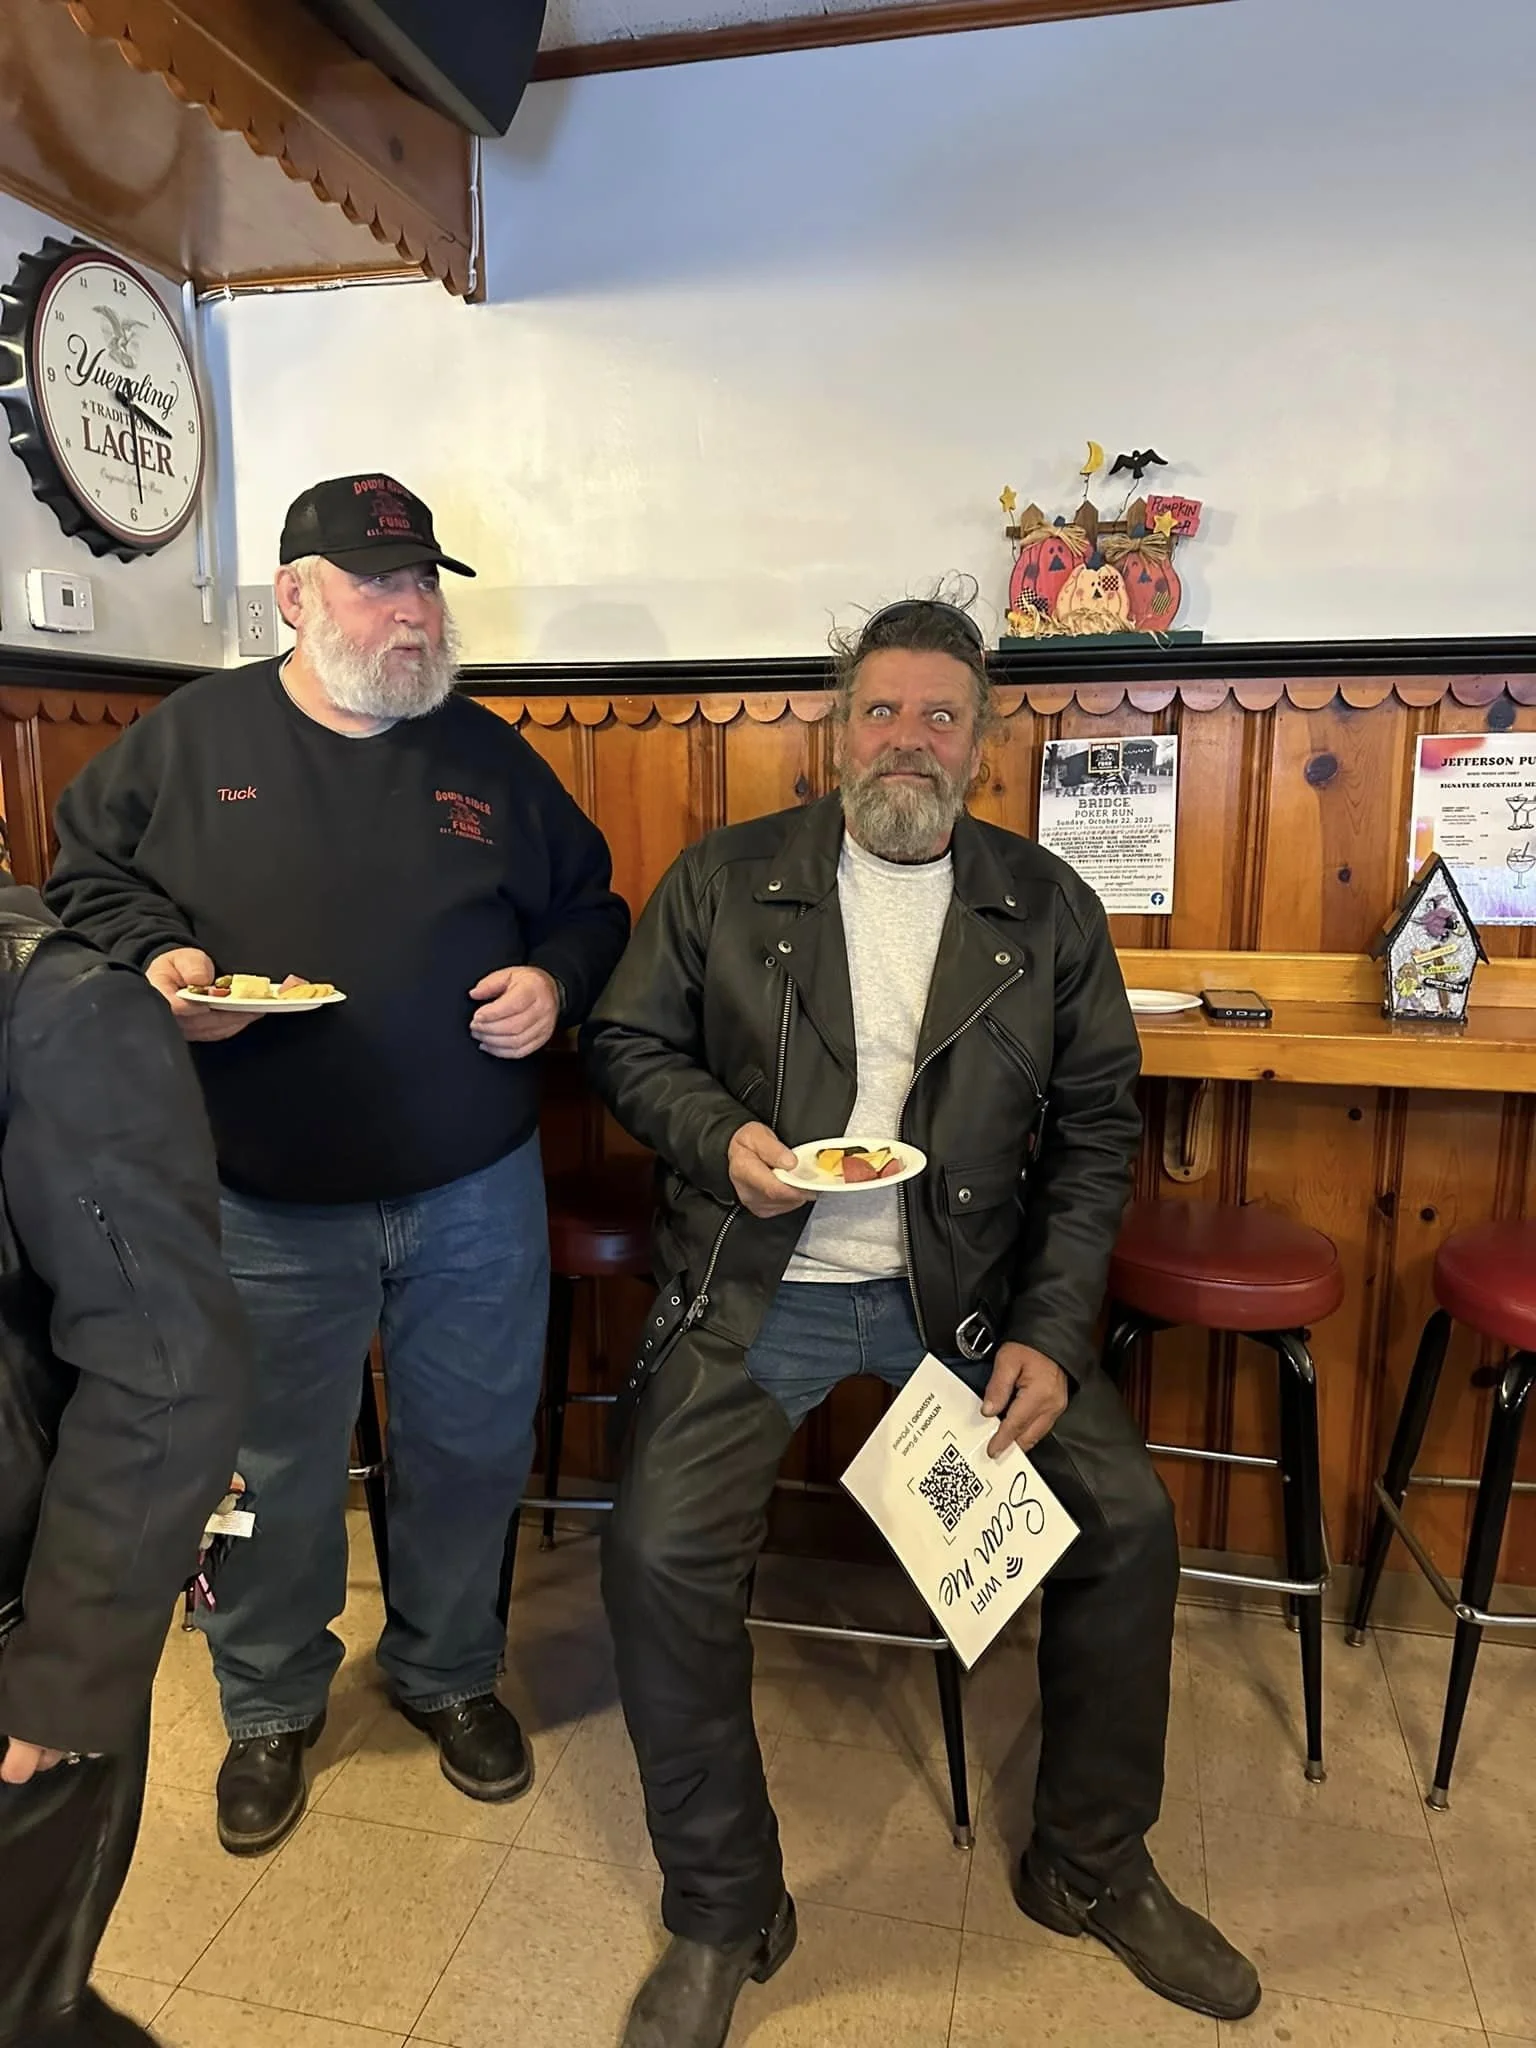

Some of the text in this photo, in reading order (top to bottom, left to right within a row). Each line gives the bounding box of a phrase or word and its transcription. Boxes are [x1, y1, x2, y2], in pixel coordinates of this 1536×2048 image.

[80, 277, 88, 288] 11
[112, 278, 127, 297] 12
[55, 310, 65, 322] 10
[47, 367, 56, 382] 9
[188, 420, 195, 434] 3
[81, 416, 175, 478] LAGER
[95, 488, 101, 498] 7
[353, 479, 385, 495] DOWN
[130, 507, 138, 521] 6
[379, 516, 410, 529] FUND
[1441, 756, 1514, 767] JEFFERSON
[217, 786, 257, 801] Tuck
[1055, 784, 1157, 798] FALL COVERED
[435, 790, 491, 816] DOWN RIDER
[1079, 797, 1131, 809] BRIDGE
[1075, 808, 1134, 818] POKER RUN
[1135, 816, 1153, 824] 2023
[453, 820, 481, 836] FUND
[920, 1404, 942, 1432] NETWORK
[938, 1471, 1045, 1607] Scan me
[971, 1576, 1002, 1616] WIFI
